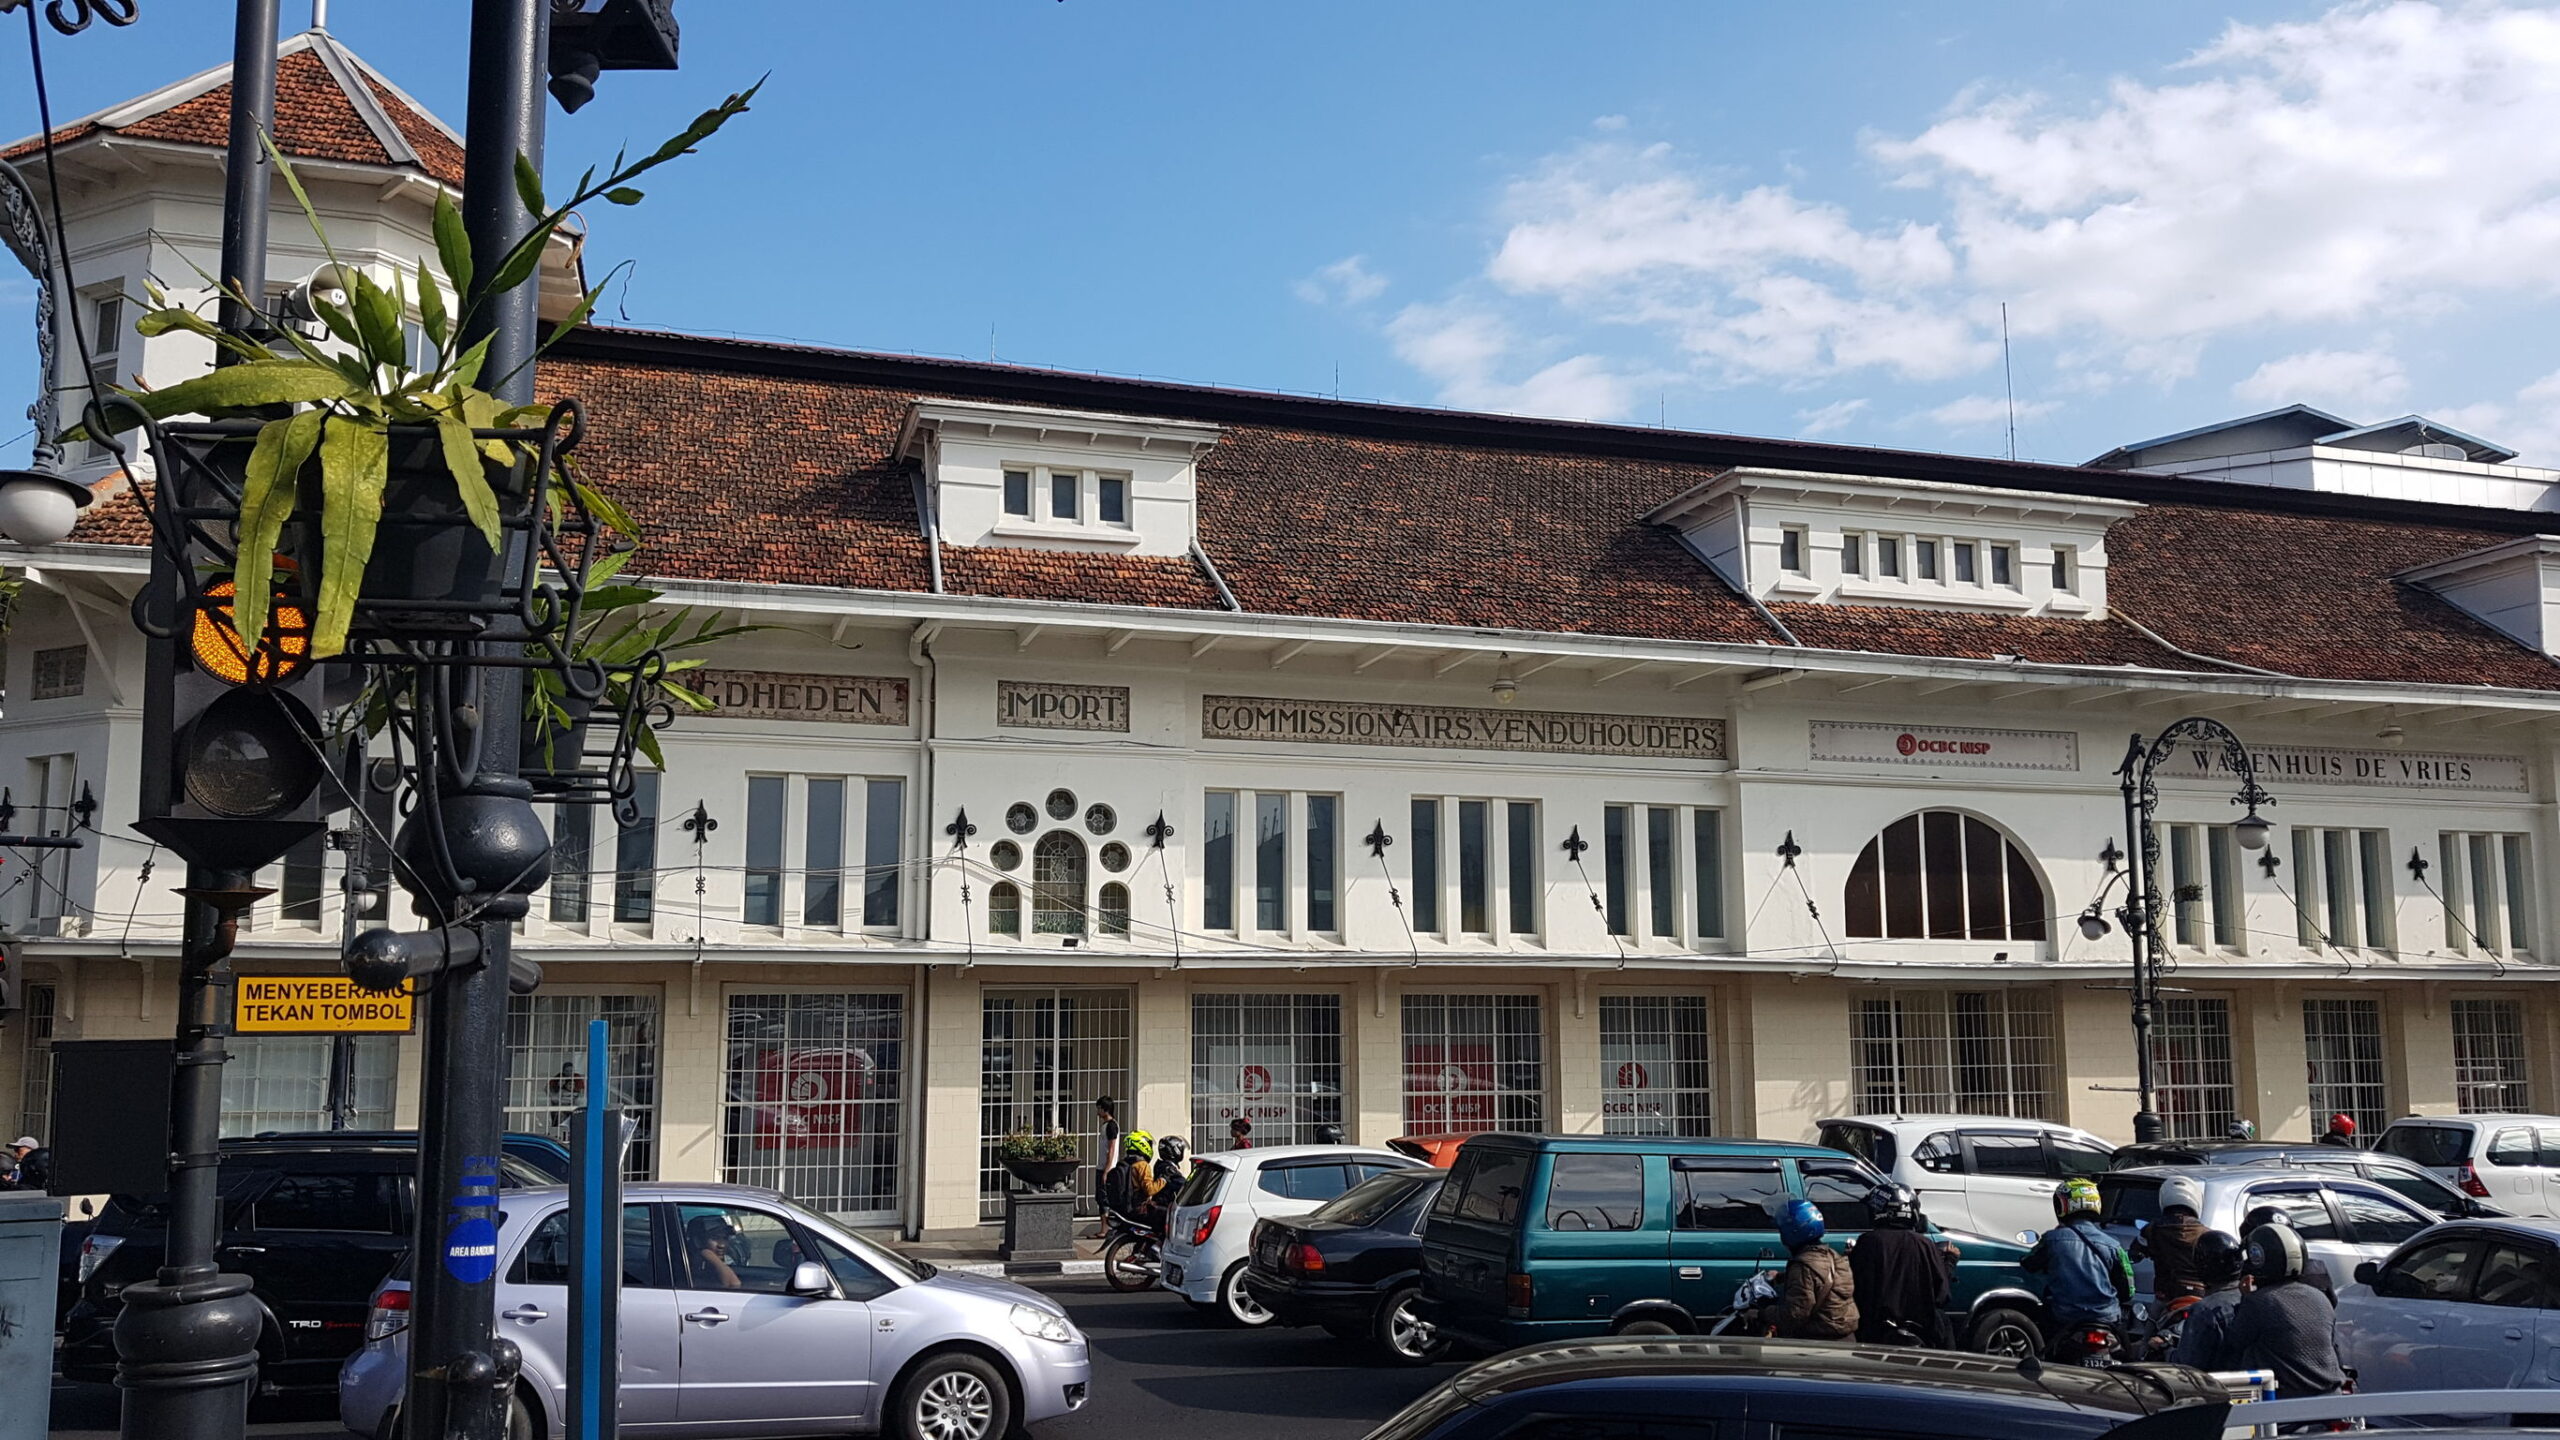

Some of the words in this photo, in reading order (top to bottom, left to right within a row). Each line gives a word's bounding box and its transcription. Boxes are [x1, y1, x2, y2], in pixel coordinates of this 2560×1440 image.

[1007, 691, 1122, 722] IMPORT
[1918, 740, 1957, 753] OCBC
[1960, 742, 1991, 755] NISP
[2356, 757, 2386, 778] DE
[2400, 759, 2472, 781] VRIES
[244, 1004, 314, 1021] TEKAN
[320, 1003, 406, 1020] TOMBOL
[1220, 1107, 1254, 1119] OCC
[1258, 1106, 1287, 1118] NISP
[450, 1246, 469, 1257] AREA
[289, 1320, 322, 1329] TRD
